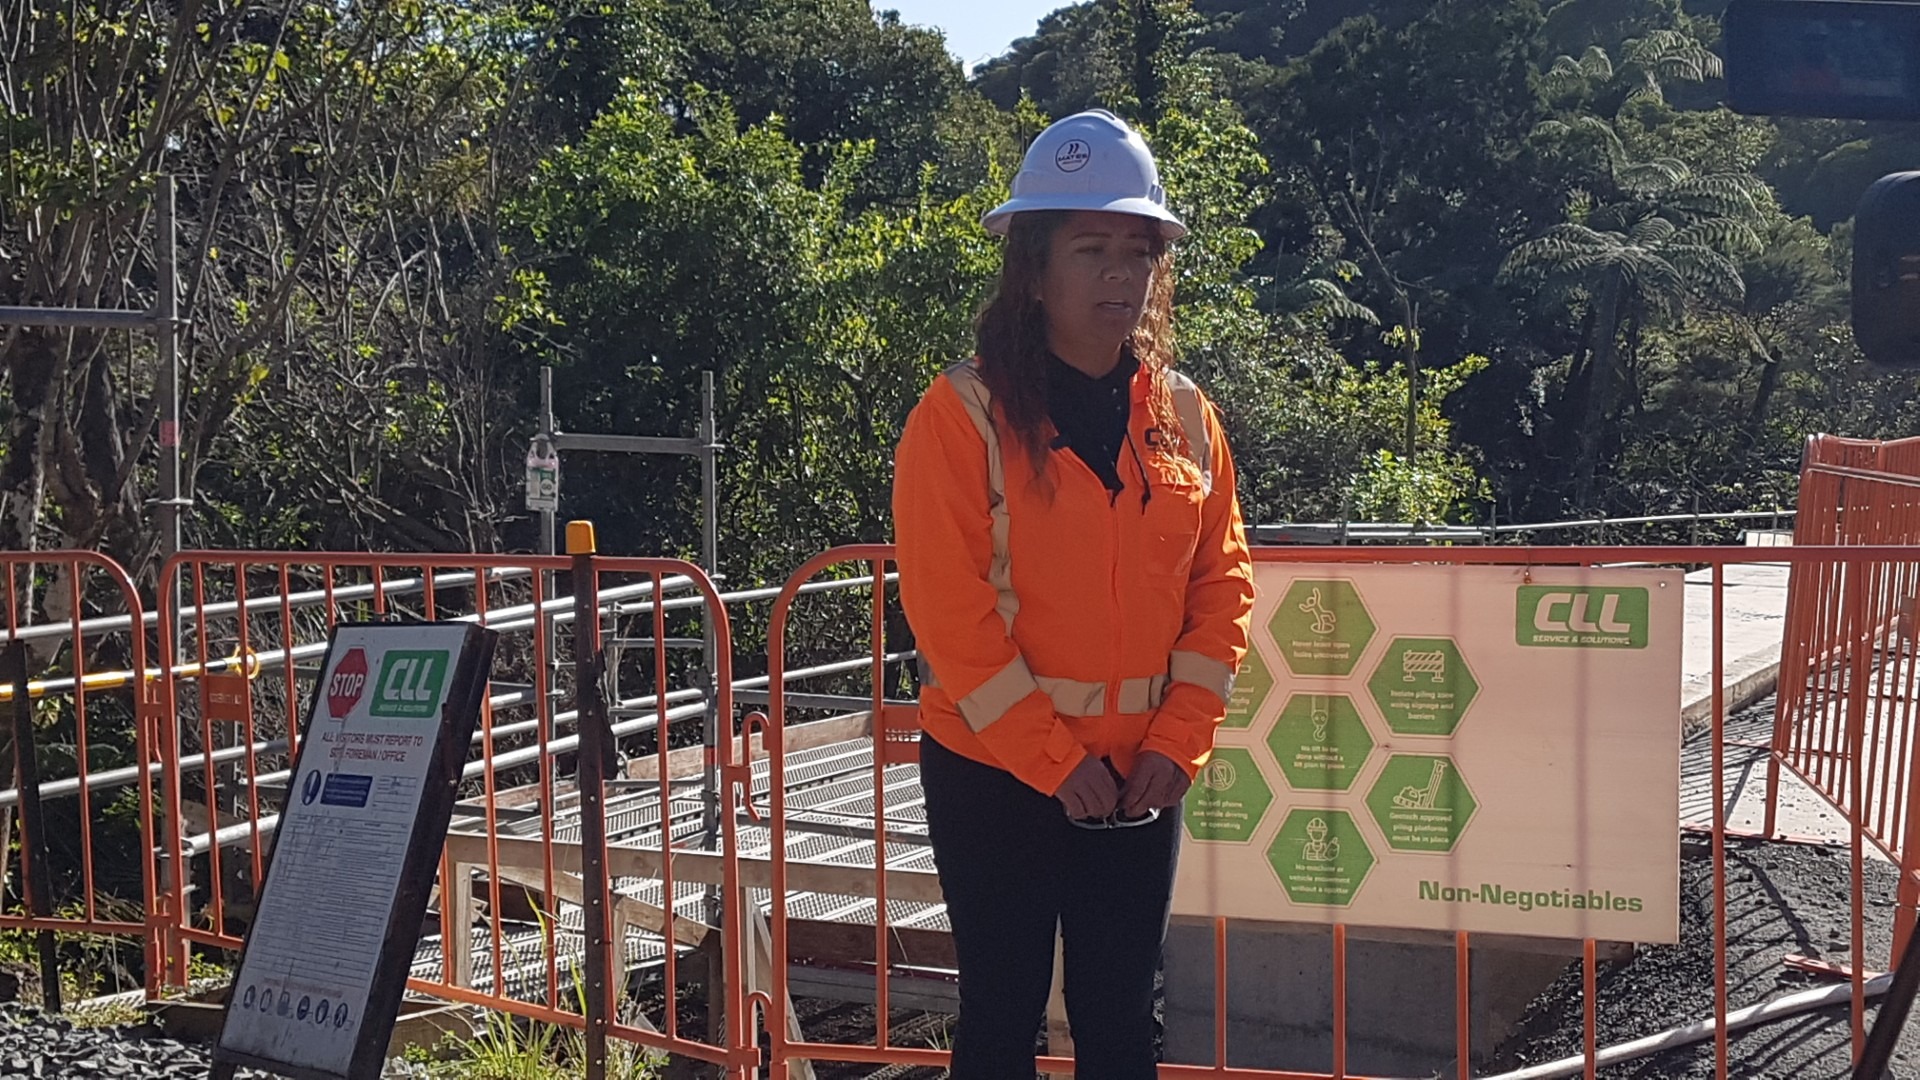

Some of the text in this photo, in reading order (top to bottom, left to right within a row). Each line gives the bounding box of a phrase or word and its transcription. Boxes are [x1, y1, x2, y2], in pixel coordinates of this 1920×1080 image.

[1533, 592, 1631, 633] CLL
[1533, 634, 1570, 643] SERVICE
[1580, 636, 1630, 644] SOLUTIONS
[330, 673, 364, 697] STOP
[383, 658, 434, 701] CLL
[322, 731, 334, 742] ALL
[365, 734, 385, 744] MUST
[385, 735, 412, 746] REPORT
[413, 735, 423, 746] TO
[345, 748, 378, 760] FOREMAN
[382, 750, 407, 762] OFFICE
[1419, 880, 1643, 913] Non-Negotiables
